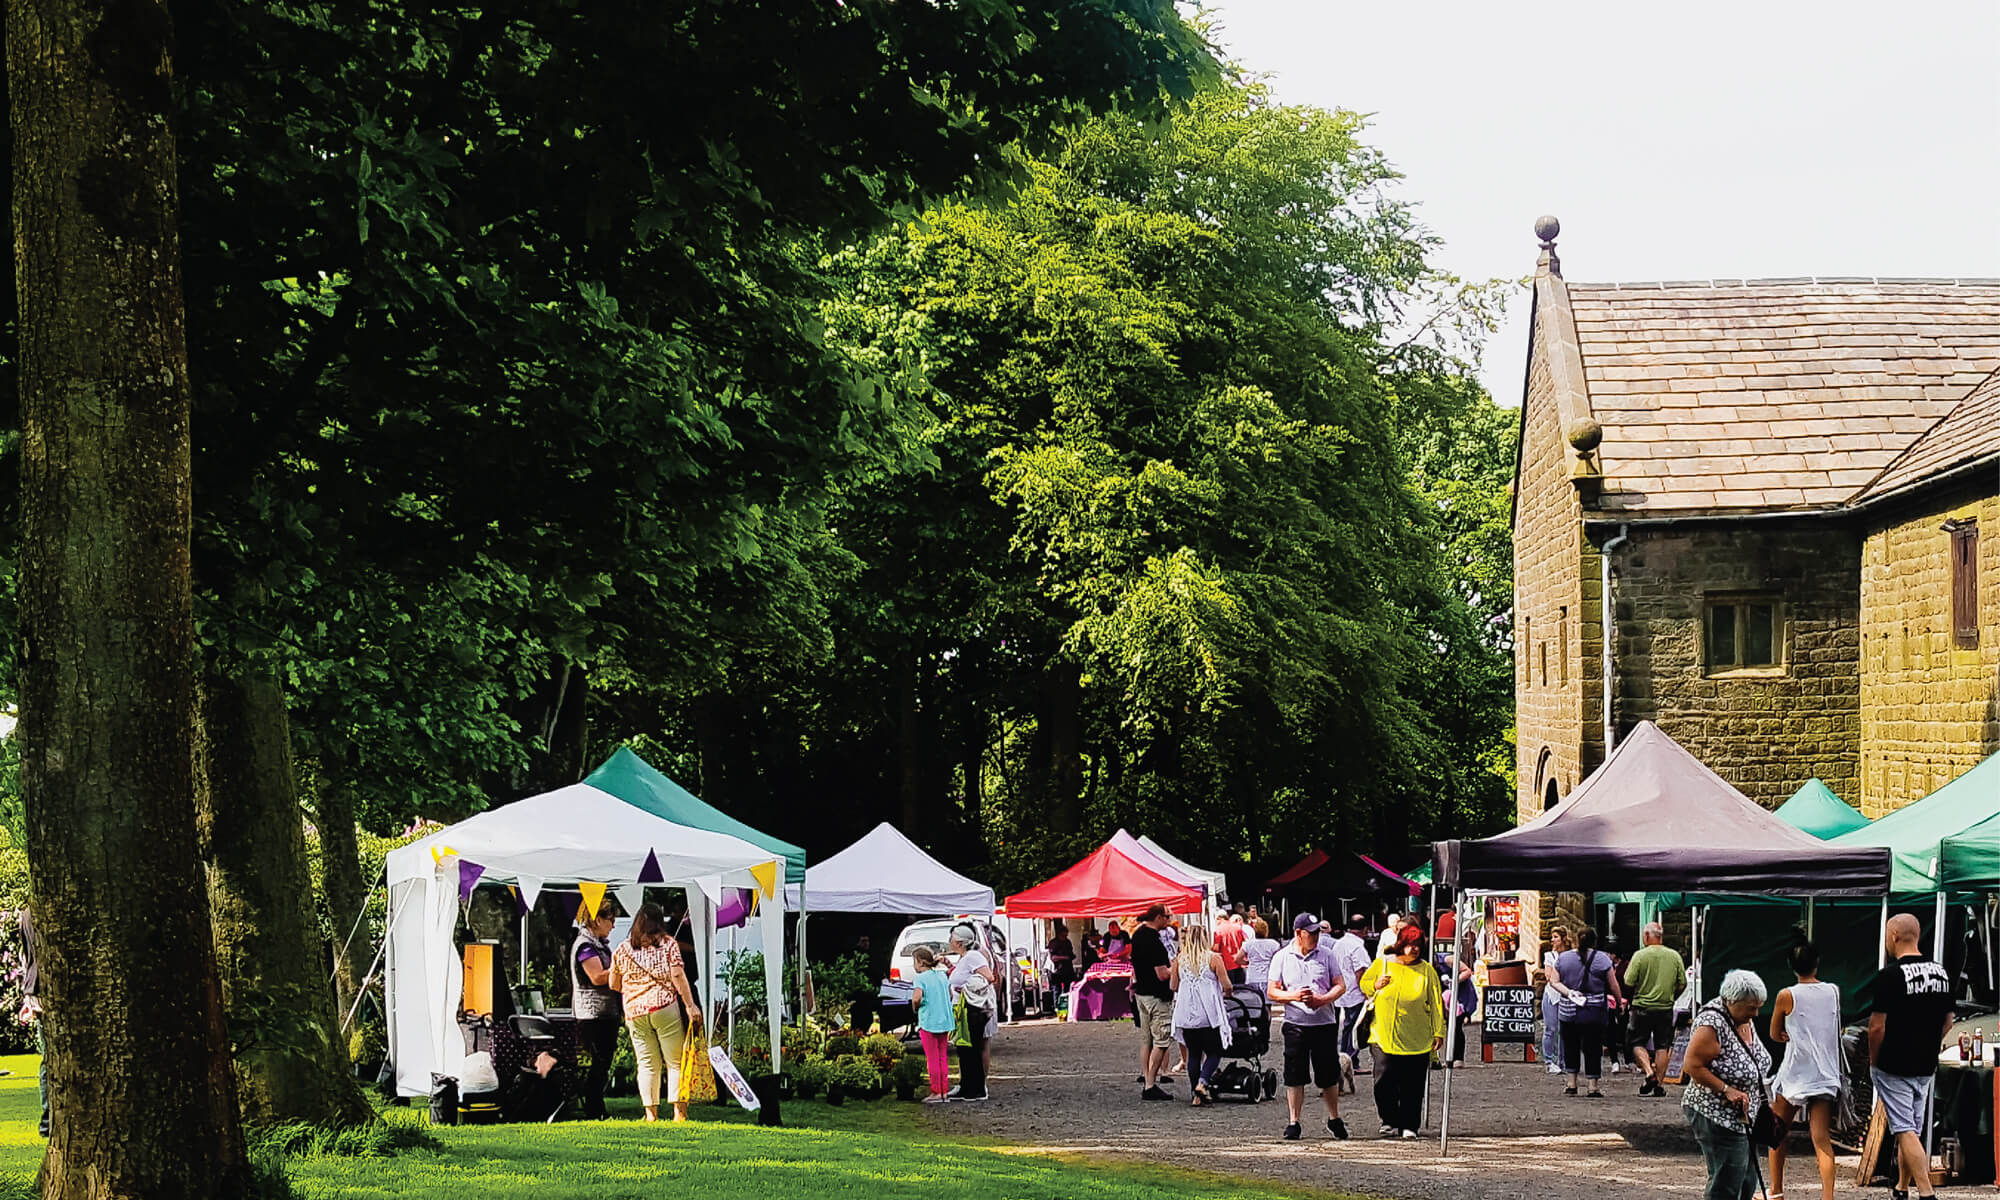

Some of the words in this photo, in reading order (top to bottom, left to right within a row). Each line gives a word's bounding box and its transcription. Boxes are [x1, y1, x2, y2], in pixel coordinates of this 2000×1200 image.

[1488, 990, 1507, 1002] HOT
[1510, 989, 1534, 1004] SOUP
[1485, 1005, 1511, 1017] BLACK
[1514, 1008, 1533, 1018] PEAS
[1485, 1020, 1504, 1032] ICE
[1509, 1022, 1535, 1032] CREAM
